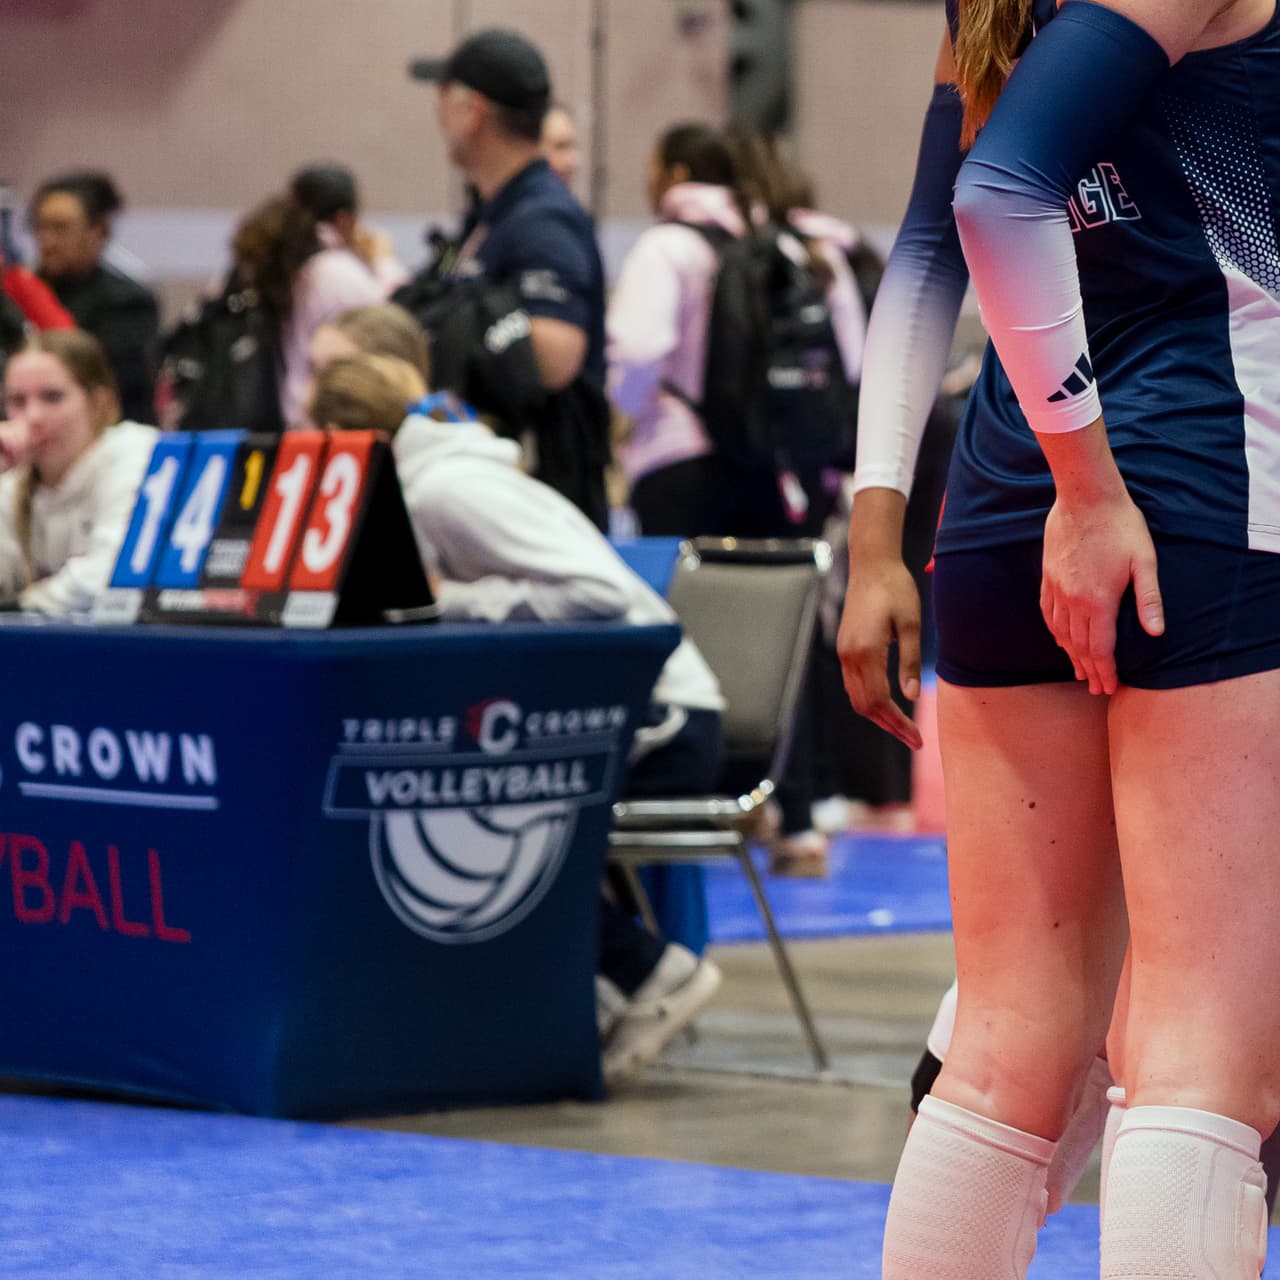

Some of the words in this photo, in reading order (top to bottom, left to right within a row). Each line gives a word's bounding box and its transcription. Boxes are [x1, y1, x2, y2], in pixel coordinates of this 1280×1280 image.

[1067, 162, 1142, 233] GE
[130, 454, 226, 574] 14
[262, 452, 360, 574] 13
[15, 721, 218, 786] CROWN
[365, 760, 589, 805] VOLLEYBALL
[0, 832, 192, 944] BALL
